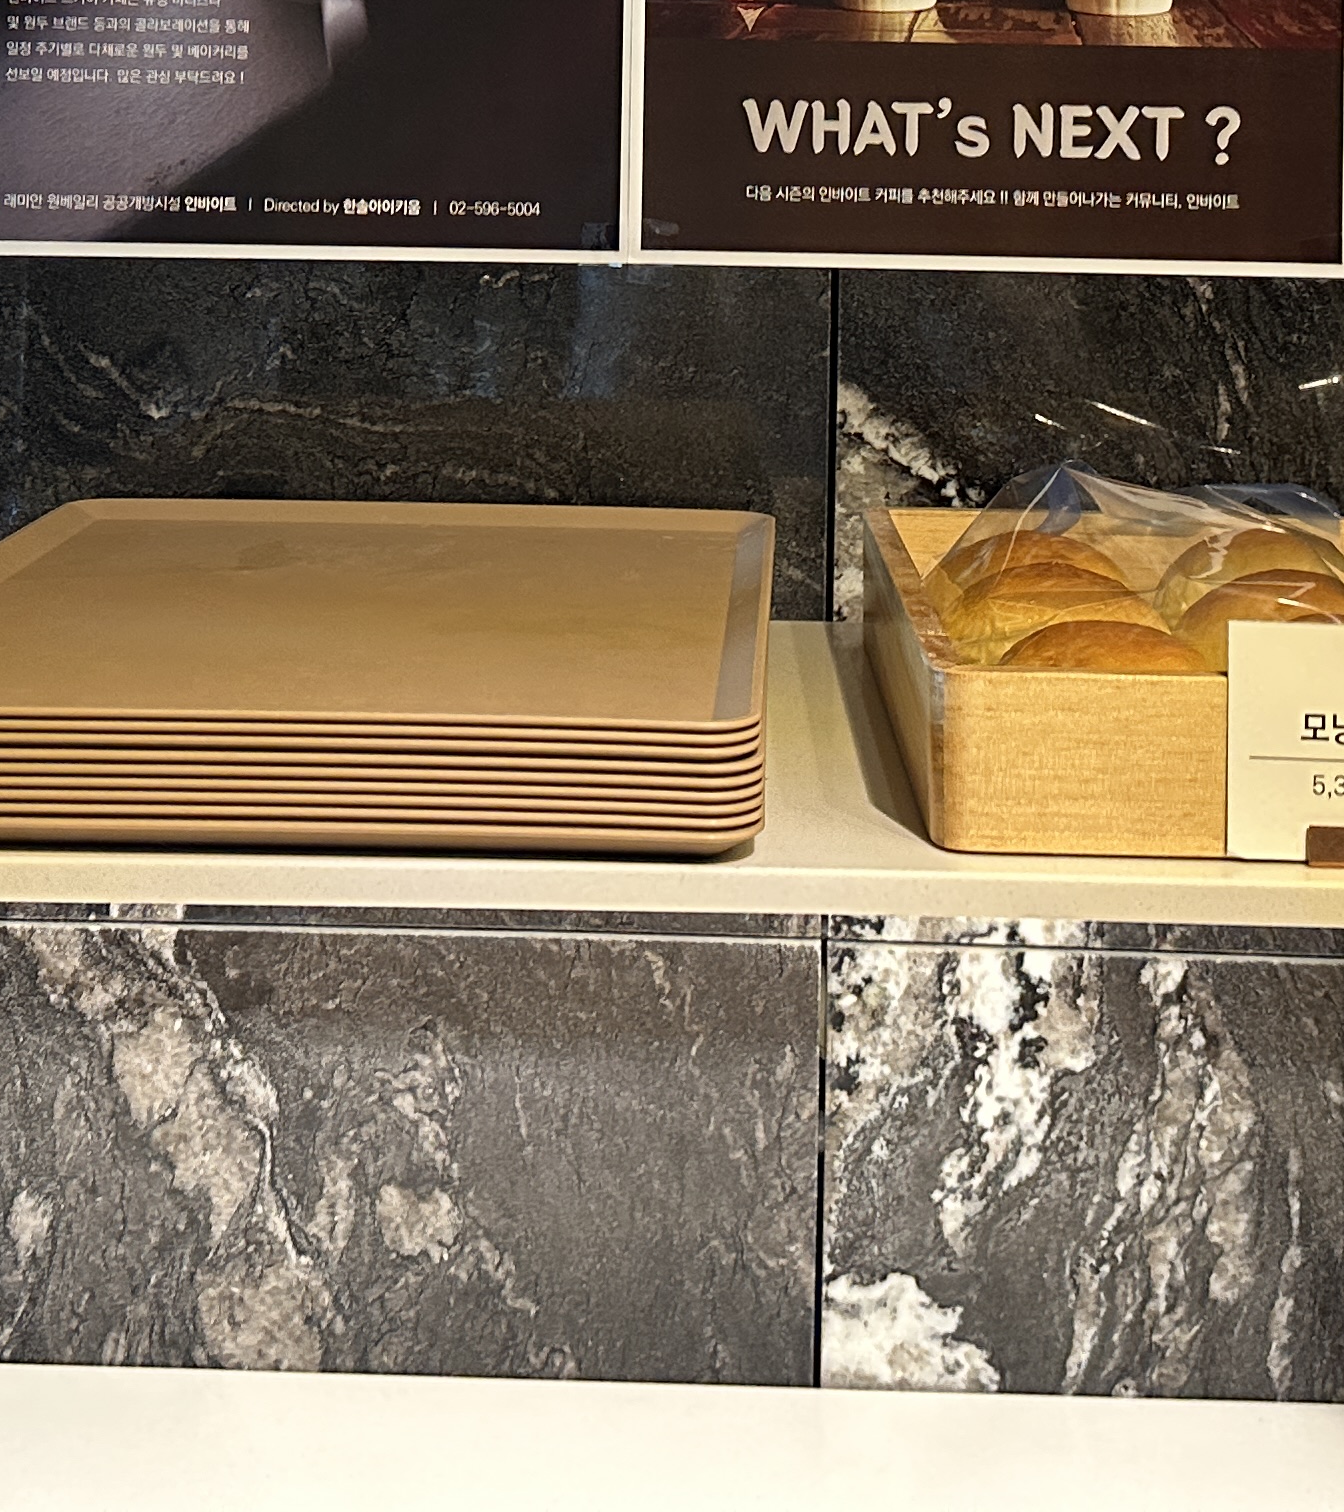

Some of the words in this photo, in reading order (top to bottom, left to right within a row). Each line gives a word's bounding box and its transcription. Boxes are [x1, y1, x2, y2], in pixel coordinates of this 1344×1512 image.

[7, 15, 19, 30] 및
[23, 16, 48, 31] 원두
[52, 16, 89, 32] 브랜드
[134, 17, 220, 34] 콜라보레이션을
[225, 19, 250, 34] 통해
[6, 41, 31, 57] 일정
[35, 41, 85, 57] 주기별로
[89, 42, 138, 58] 다채로운
[142, 43, 167, 58] 원두
[172, 44, 183, 59] 및
[187, 44, 249, 60] 베이커리를
[5, 67, 43, 82] 선보일
[117, 69, 141, 84] 많은
[146, 69, 171, 84] 관심
[174, 70, 236, 85] 부탁드려요
[742, 96, 991, 159] WHAT's
[1013, 102, 1185, 161] NEXT
[1205, 106, 1241, 166] ?
[4, 193, 43, 209] 래미안
[46, 193, 99, 211] 원베일리
[102, 195, 181, 212] 공공개방시설
[184, 196, 237, 212] 인바이트
[264, 197, 320, 213] Directed
[323, 198, 340, 215] by
[746, 185, 772, 202] 다음
[776, 185, 815, 203] 시즌의
[819, 186, 871, 203] 인바이트
[874, 187, 914, 205] 커피를
[917, 188, 996, 206] 추천해주세요
[1013, 190, 1040, 206] 함께
[1042, 190, 1122, 209] 만들어나가는
[1186, 193, 1240, 210] 인바이트
